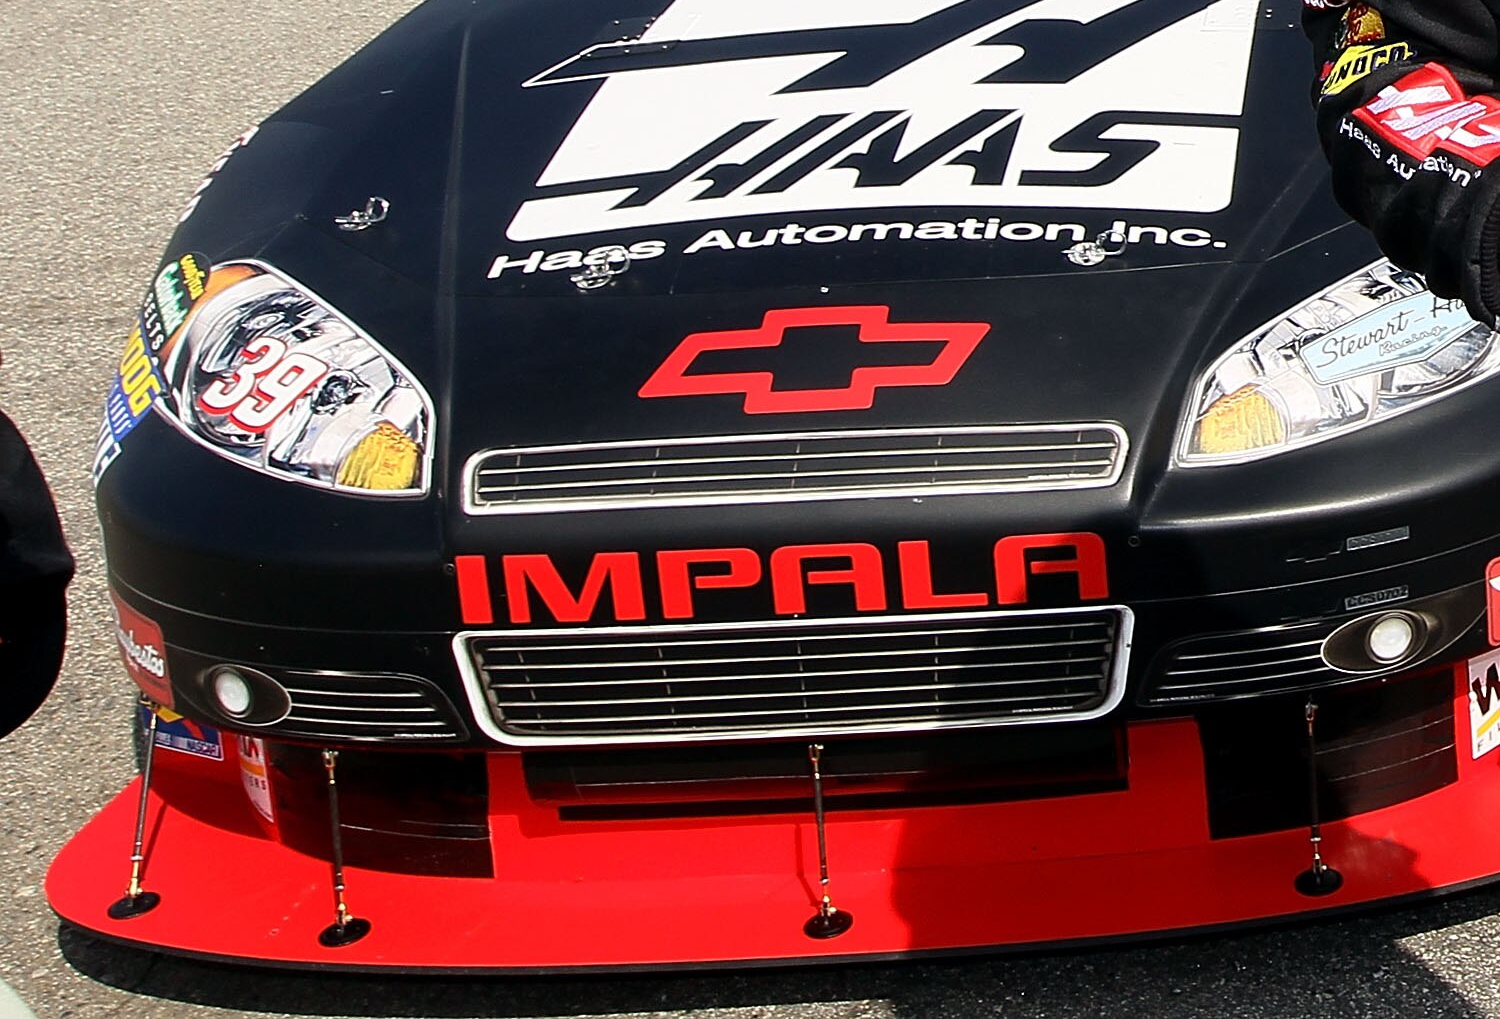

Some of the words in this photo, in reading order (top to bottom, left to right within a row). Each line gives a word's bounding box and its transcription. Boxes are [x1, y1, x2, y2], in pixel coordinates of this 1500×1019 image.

[1338, 118, 1381, 159] Haas
[486, 241, 666, 281] Haas
[682, 216, 1087, 254] Automation
[1110, 219, 1229, 252] Inc.
[1317, 310, 1411, 369] Stewart
[1379, 326, 1447, 358] Racing
[200, 335, 329, 433] 39
[454, 531, 1110, 625] IMPALA
